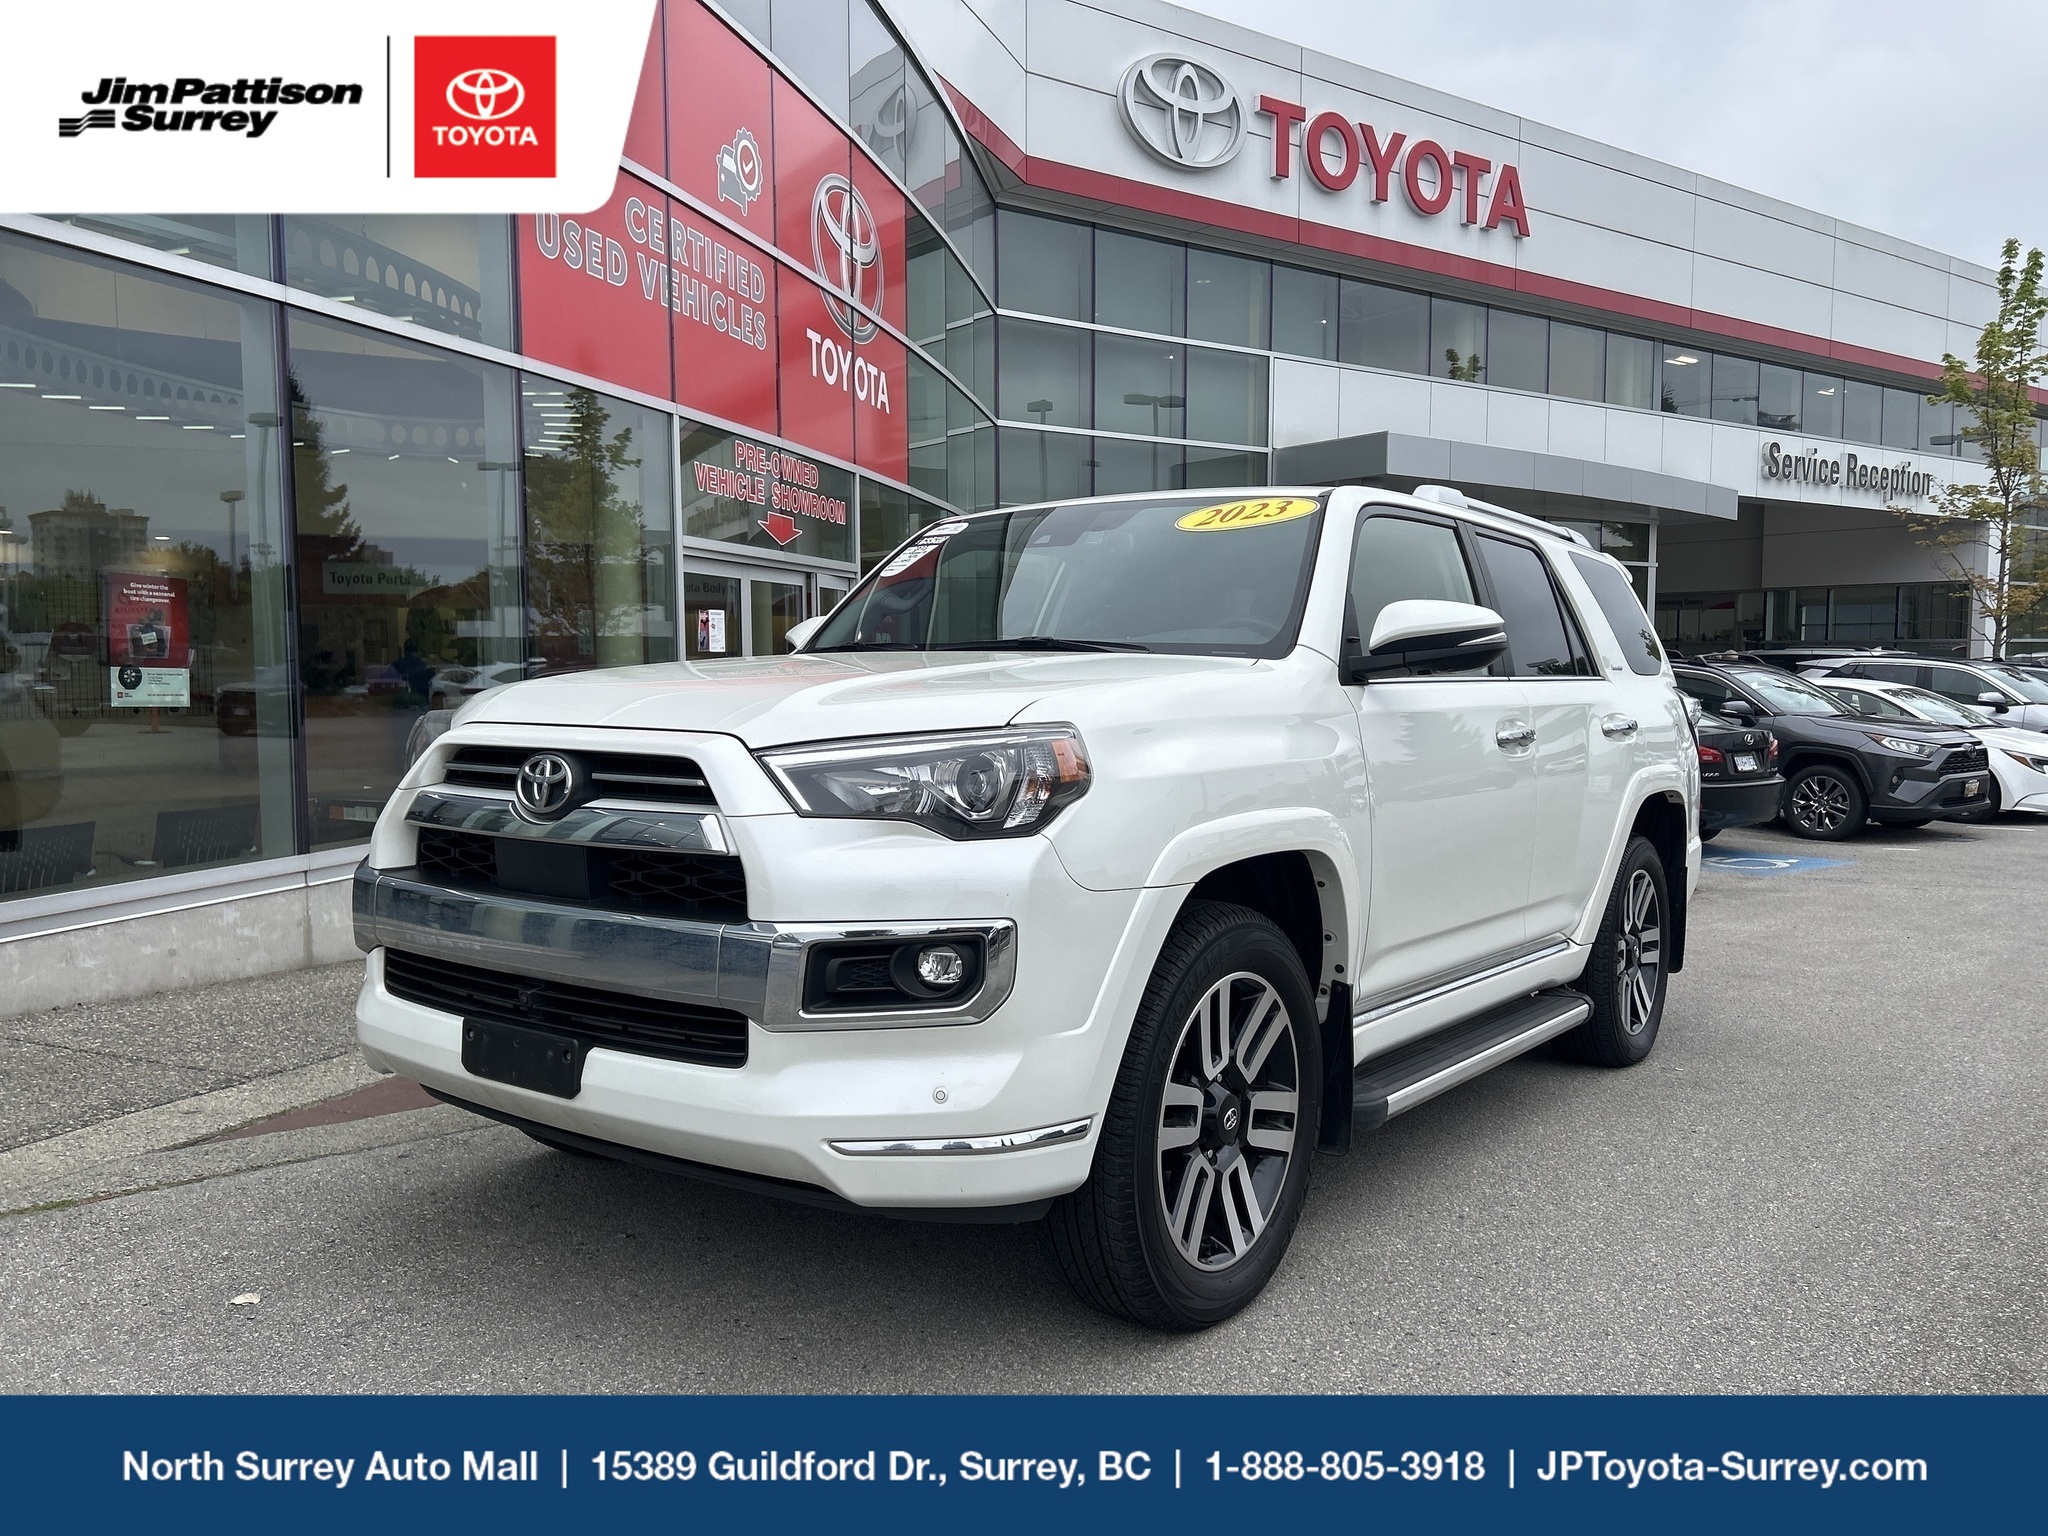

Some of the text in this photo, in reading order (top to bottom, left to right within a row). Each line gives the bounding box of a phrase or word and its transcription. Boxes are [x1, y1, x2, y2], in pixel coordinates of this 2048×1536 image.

[1254, 94, 1531, 239] TOYOTA
[535, 212, 767, 350] USED VEHICLES
[624, 197, 766, 304] CERTIFIED
[806, 327, 890, 414] TOYOTA
[694, 461, 765, 505] VEHICLE
[771, 481, 846, 525] SHOWROOM
[735, 439, 819, 490] PRE-OWNED
[1763, 441, 1931, 501] Service Reception
[1193, 500, 1294, 528] 2023
[329, 571, 411, 587] Toyota Parts
[702, 582, 726, 595] Body
